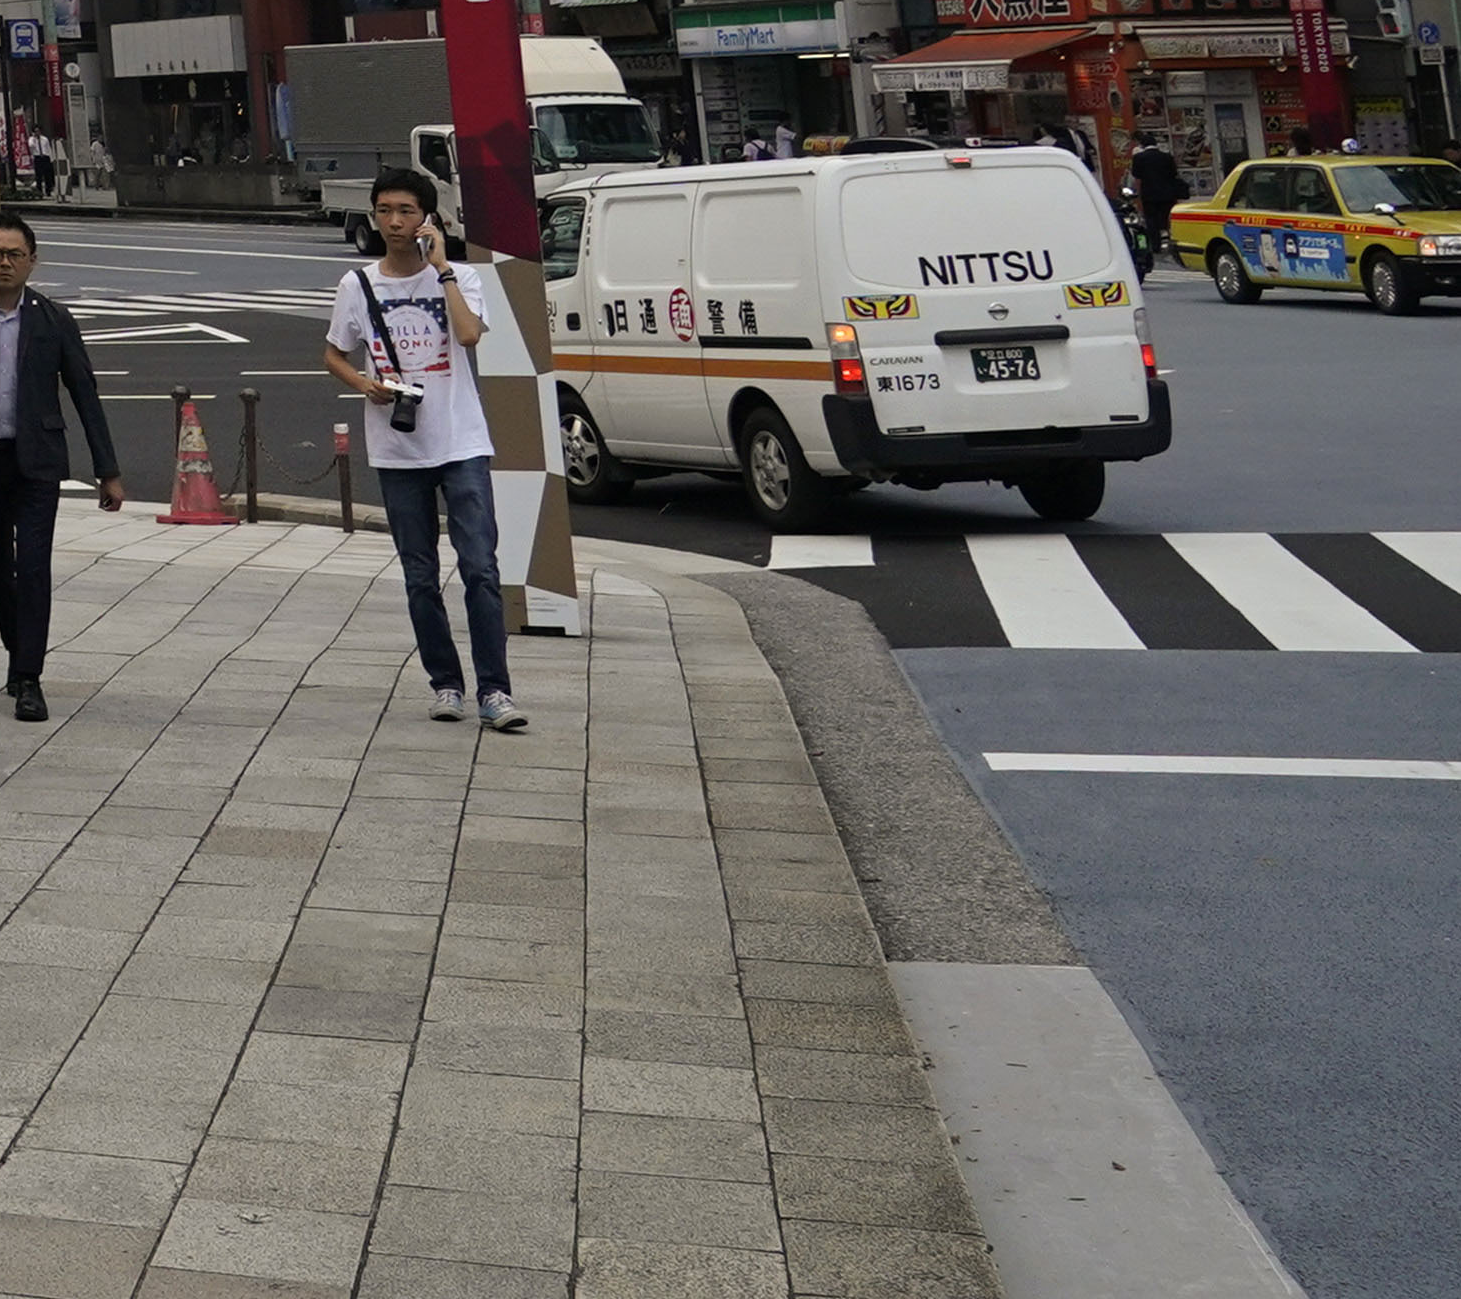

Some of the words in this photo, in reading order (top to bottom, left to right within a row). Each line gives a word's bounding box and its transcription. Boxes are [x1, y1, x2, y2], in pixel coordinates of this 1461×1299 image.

[717, 28, 775, 50] FamilyMart
[1296, 12, 1307, 44] TOKYO
[1311, 12, 1326, 45] TOKYO
[1300, 45, 1311, 73] 2020
[1317, 46, 1329, 73] 2020
[1345, 224, 1367, 232] TAXI
[918, 250, 1054, 287] NITTSU
[707, 299, 759, 335] 警備
[387, 324, 432, 337] BILLA
[392, 339, 433, 350] ONG
[870, 356, 924, 366] CARAVAN
[988, 359, 1038, 380] 45-76
[877, 374, 942, 393] 東1673
